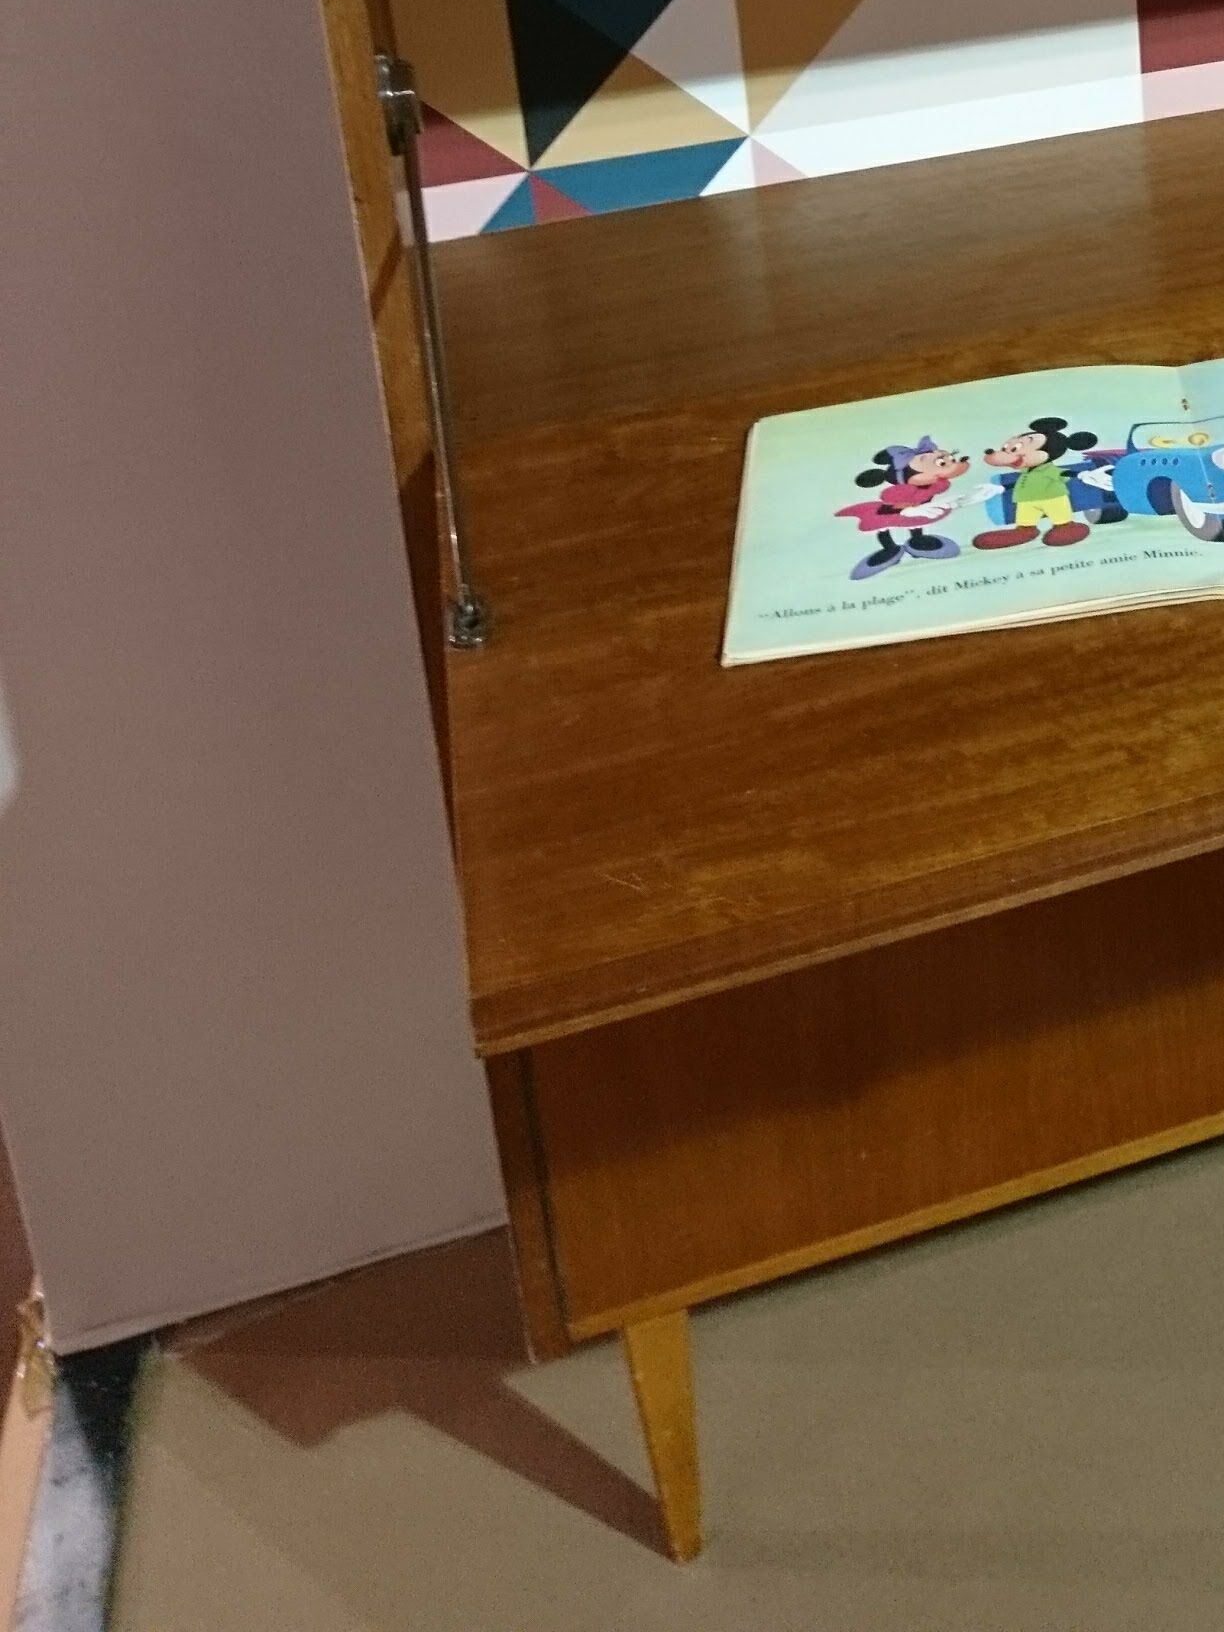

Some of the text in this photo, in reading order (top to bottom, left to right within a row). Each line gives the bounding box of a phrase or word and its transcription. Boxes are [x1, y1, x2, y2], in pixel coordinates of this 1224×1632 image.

[841, 600, 856, 610] la
[926, 584, 948, 596] dit
[955, 571, 1010, 590] Mickey
[1029, 568, 1045, 577] sa
[1050, 557, 1095, 576] petite
[1099, 553, 1138, 565] amie
